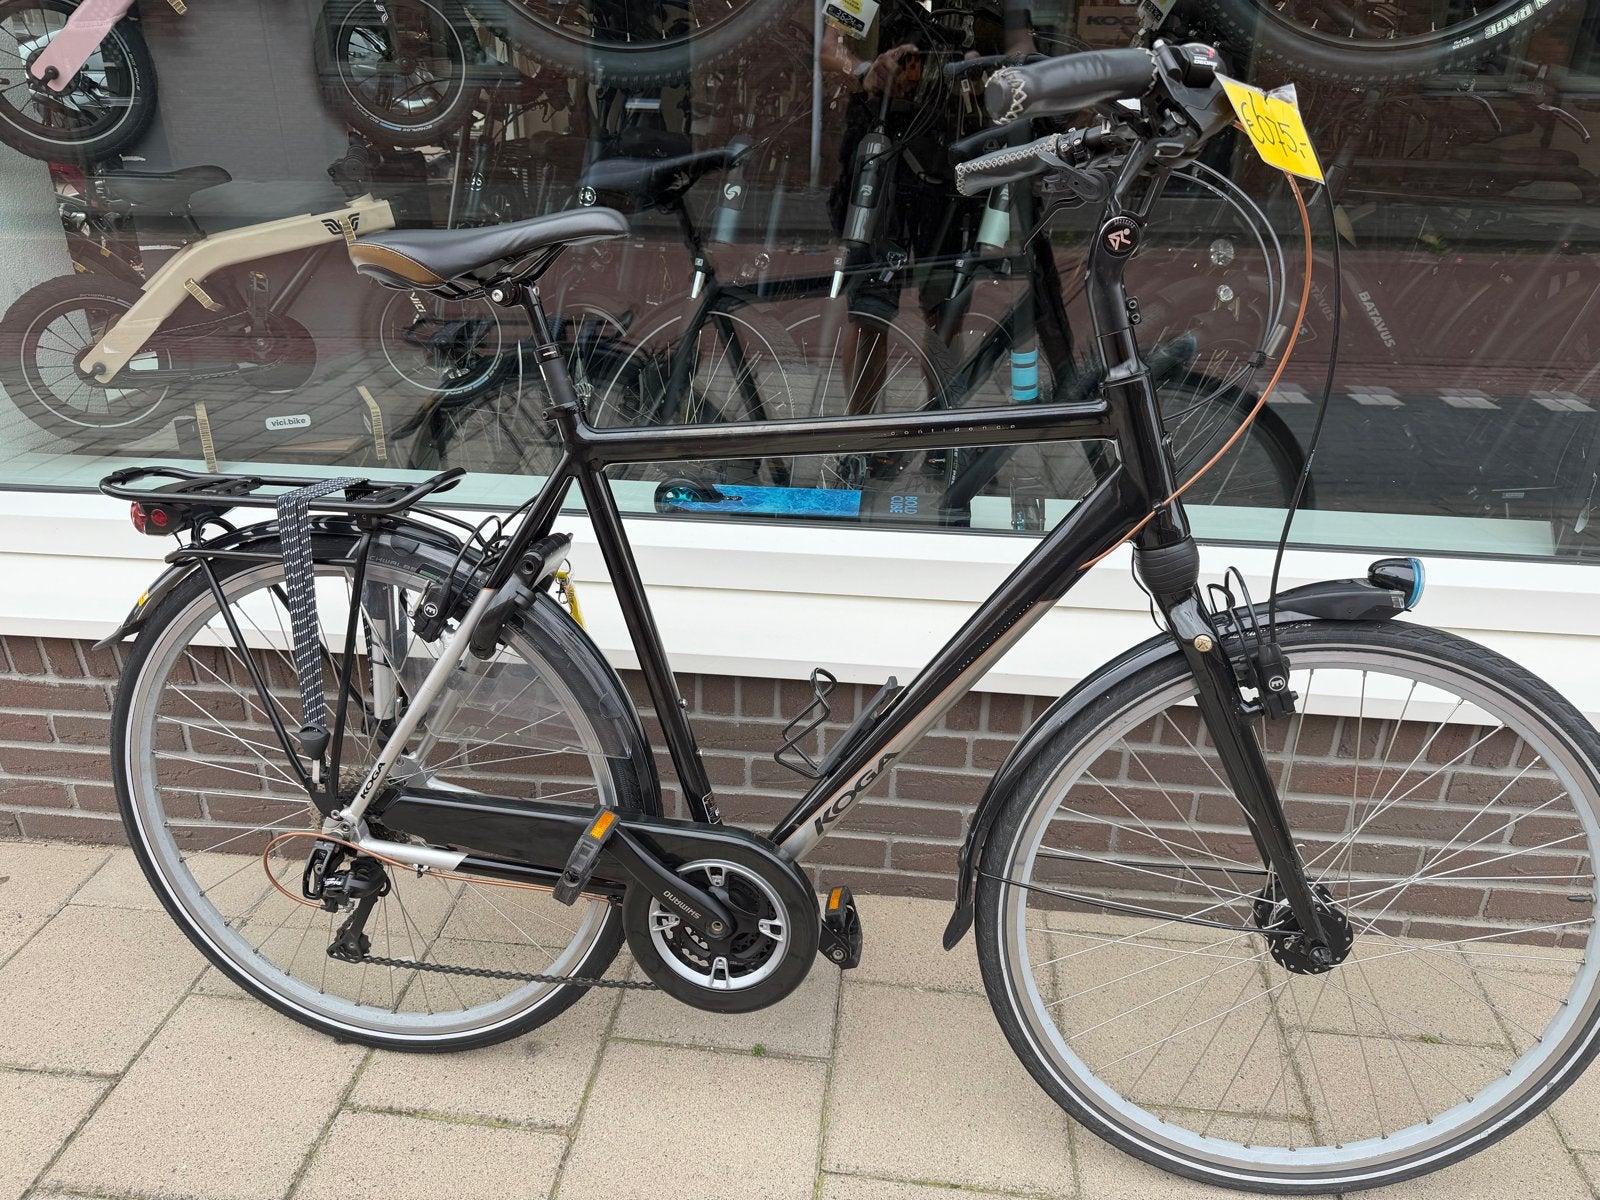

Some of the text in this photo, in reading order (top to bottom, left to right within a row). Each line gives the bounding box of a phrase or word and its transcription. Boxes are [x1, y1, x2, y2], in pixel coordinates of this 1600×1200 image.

[1087, 16, 1140, 25] KOG
[1358, 290, 1396, 348] BATAVUS
[270, 417, 306, 427] vici.bike
[890, 495, 904, 513] CUBE
[904, 495, 918, 515] BOLD
[360, 762, 386, 800] KOGA
[815, 751, 900, 837] KOGA
[663, 890, 702, 919] SHIMANO
